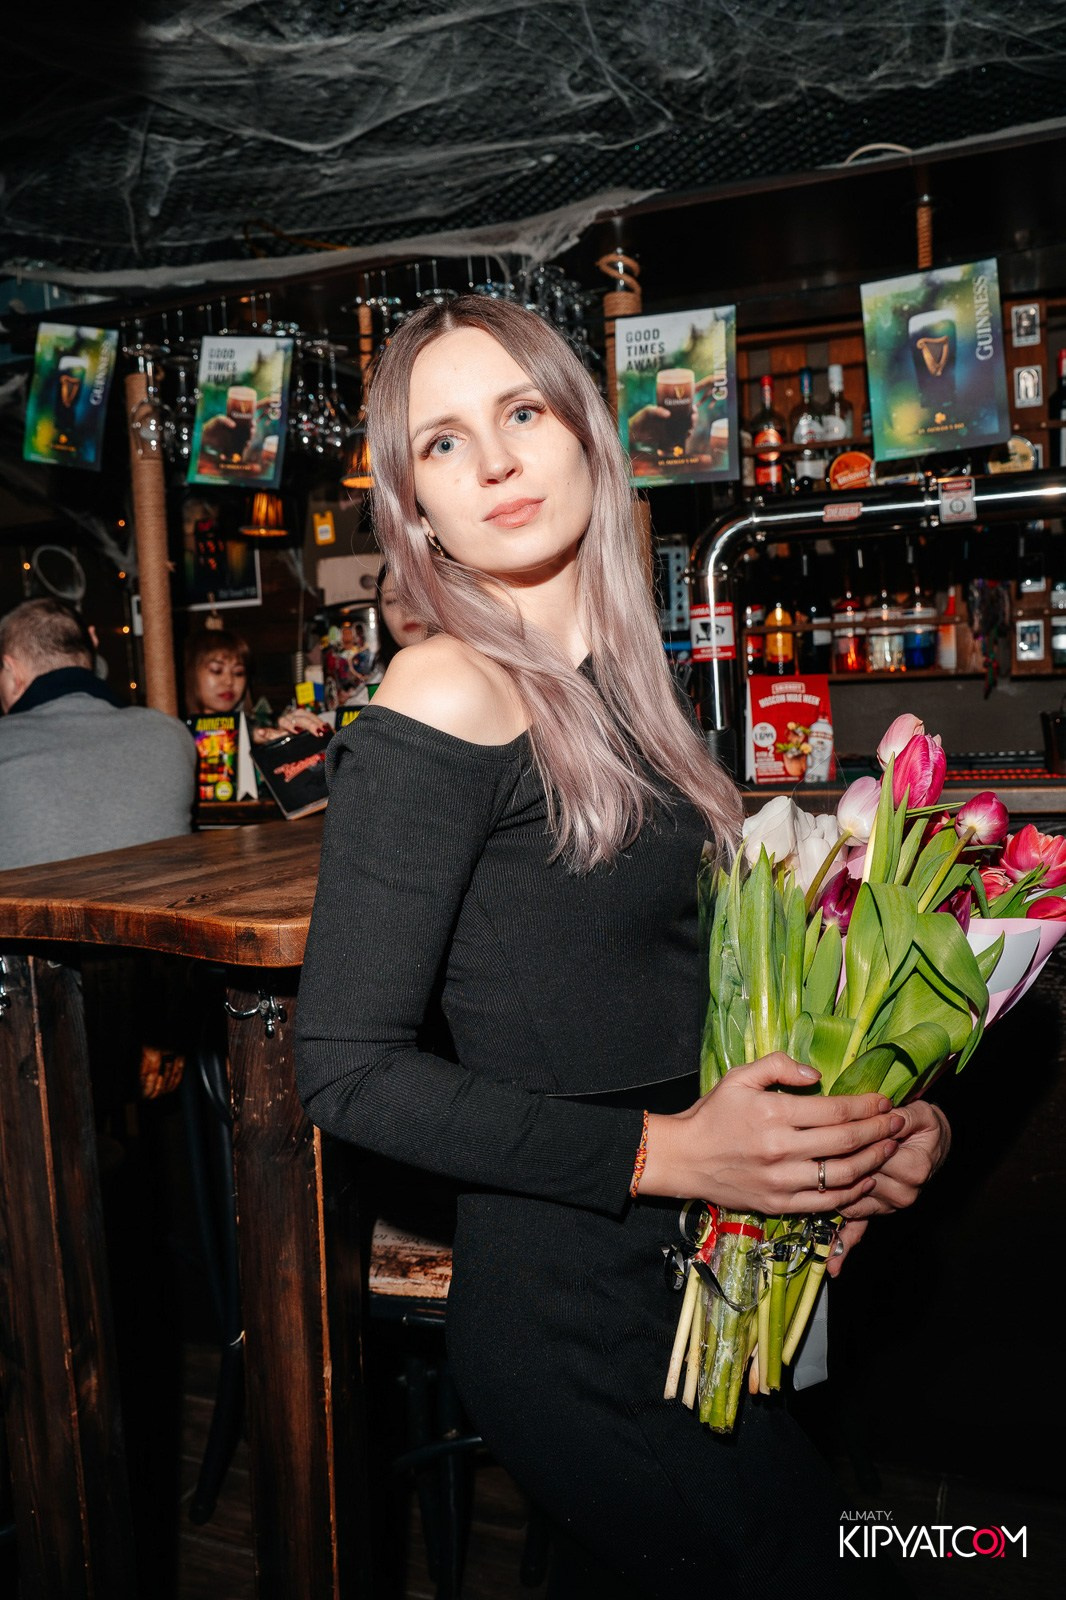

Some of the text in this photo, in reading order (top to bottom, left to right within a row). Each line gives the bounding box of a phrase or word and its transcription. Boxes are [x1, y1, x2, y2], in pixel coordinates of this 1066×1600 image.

[973, 275, 994, 361] GUINNESS
[625, 328, 660, 343] GOOD
[626, 342, 665, 357] TIMES
[626, 356, 665, 371] AWAIT
[195, 716, 235, 731] AMNESIA
